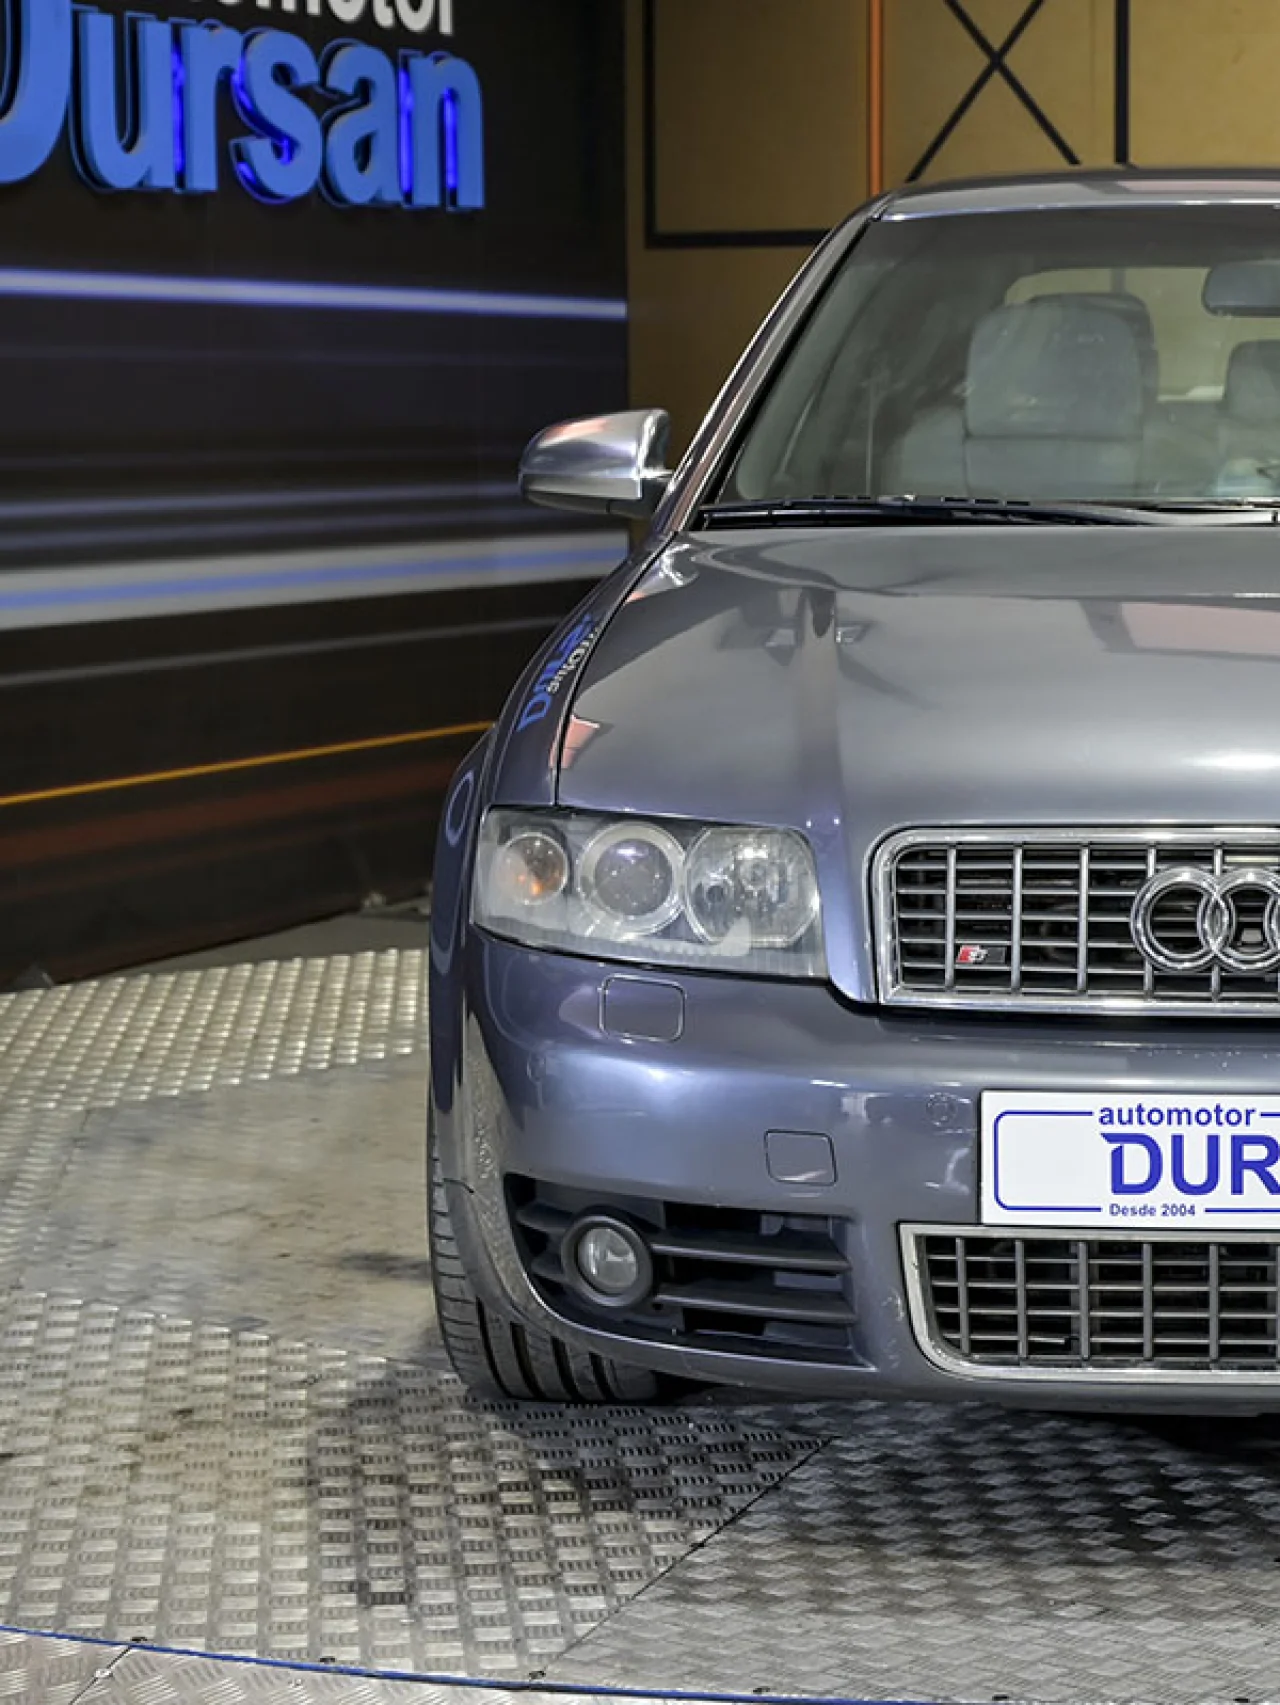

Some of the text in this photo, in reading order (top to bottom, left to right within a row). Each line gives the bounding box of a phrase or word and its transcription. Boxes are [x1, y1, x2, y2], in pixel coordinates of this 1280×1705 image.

[1099, 1102, 1256, 1126] automotor
[1109, 1203, 1196, 1217] Desde 2004
